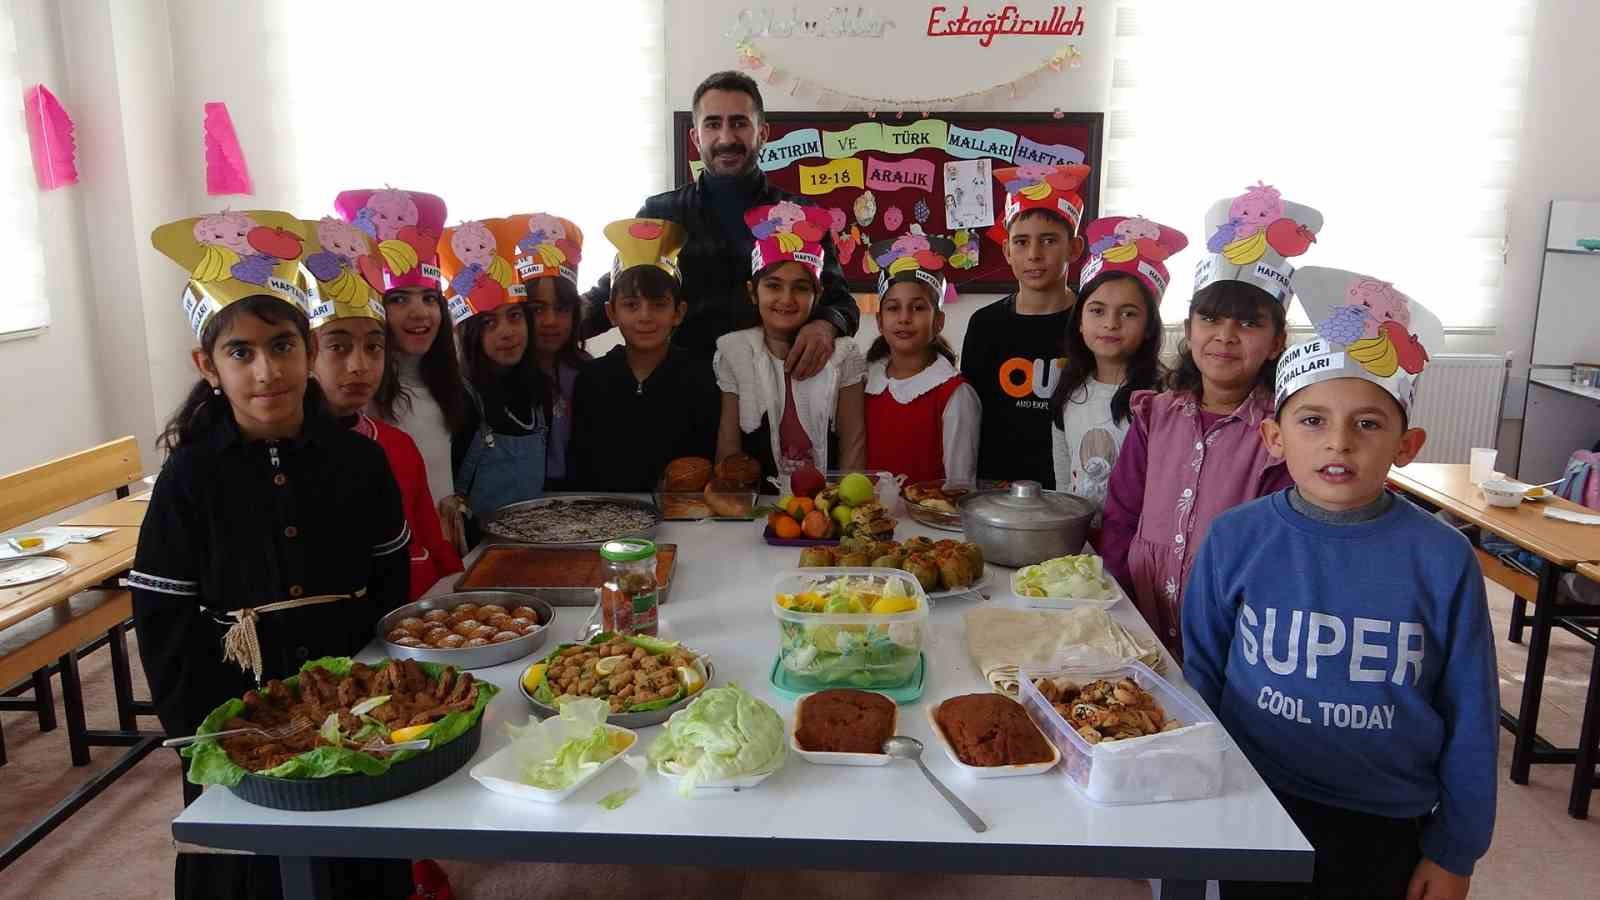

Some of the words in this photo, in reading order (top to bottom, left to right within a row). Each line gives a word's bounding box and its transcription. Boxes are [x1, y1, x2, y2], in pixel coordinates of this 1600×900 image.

[758, 140, 819, 163] YATIRIM
[838, 137, 858, 151] VE
[892, 130, 930, 145] TÜRK
[949, 133, 1014, 158] MALLARI
[810, 172, 850, 186] 12-18
[870, 168, 928, 187] ARALIK
[1303, 342, 1321, 354] VE
[998, 357, 1066, 399] OU
[1283, 357, 1330, 385] MALLARI
[1240, 603, 1425, 687] SUPER
[1257, 686, 1312, 724] COOL
[1318, 701, 1396, 730] TODAY
